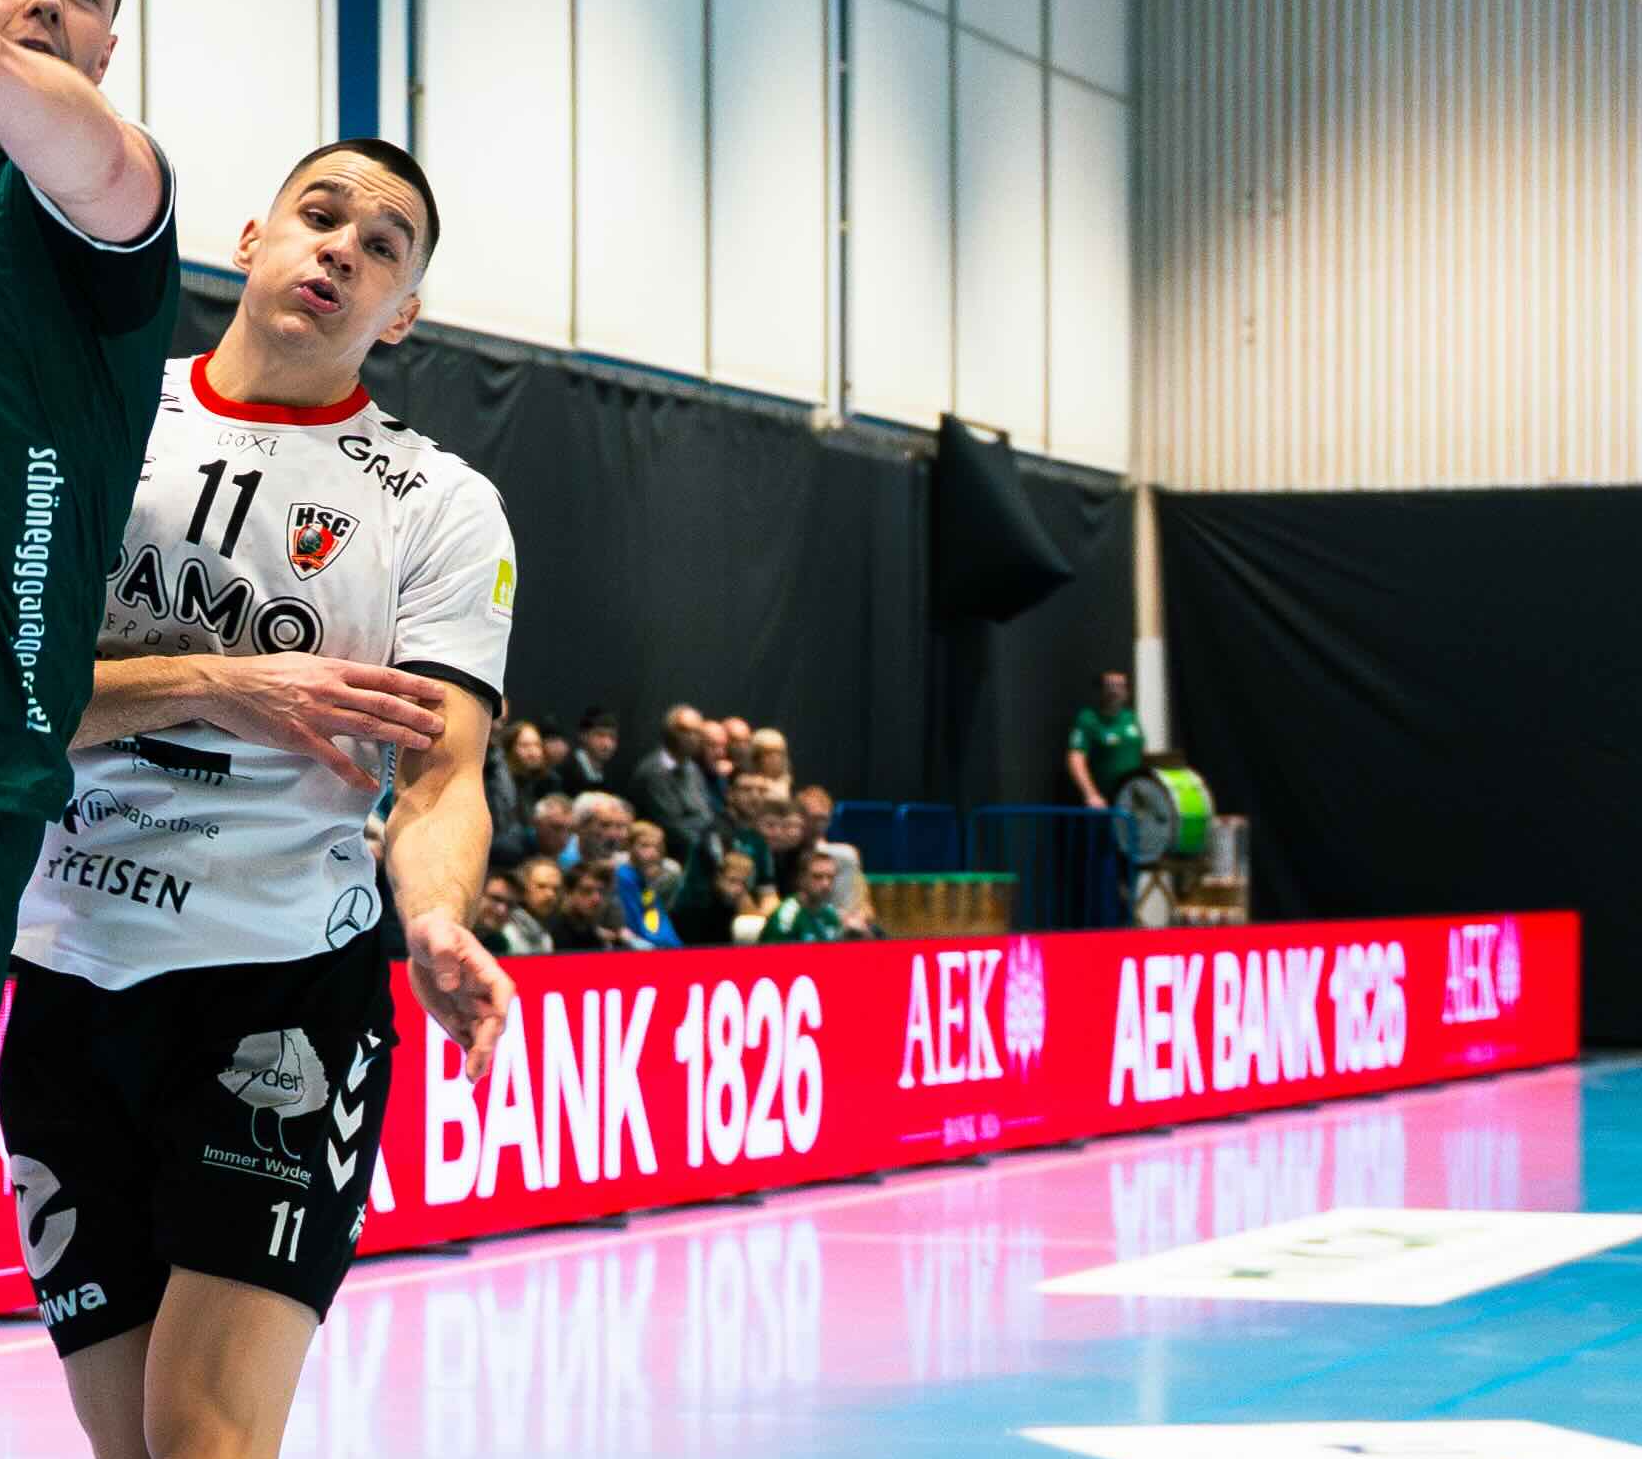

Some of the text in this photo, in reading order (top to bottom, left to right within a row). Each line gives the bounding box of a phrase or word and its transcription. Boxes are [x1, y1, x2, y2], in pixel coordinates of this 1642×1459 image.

[186, 459, 264, 559] 11
[338, 434, 428, 501] GRAF
[295, 507, 351, 538] HSC
[105, 612, 213, 653] FROS
[107, 543, 324, 656] AMO
[899, 949, 1004, 1089] AEK
[1441, 923, 1500, 1024] AEK
[1109, 941, 1407, 1107] AEK BANK 1826
[424, 974, 824, 1206] BANK 1826
[203, 1144, 260, 1168] Immer
[268, 1200, 307, 1263] 11
